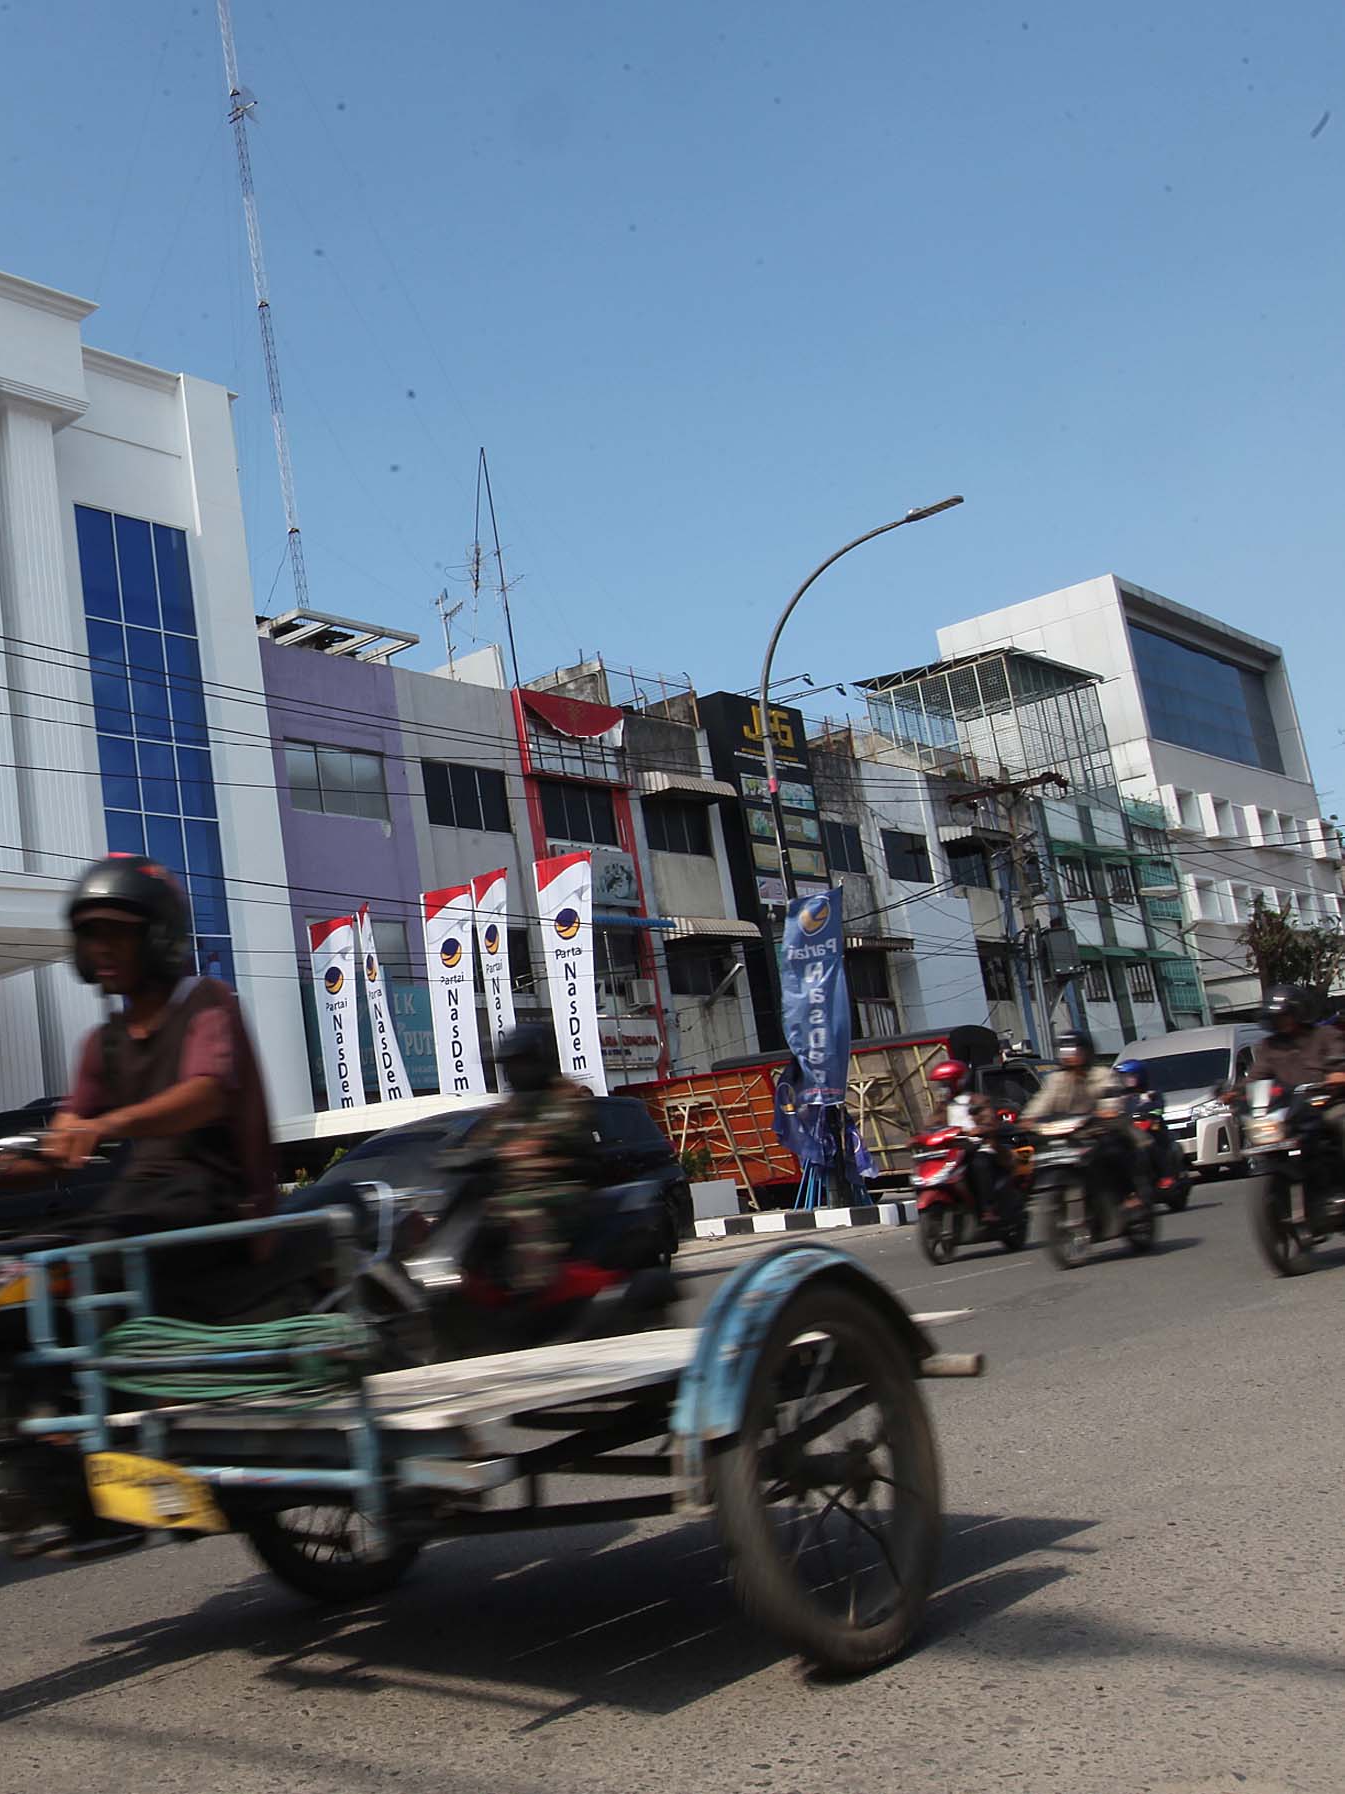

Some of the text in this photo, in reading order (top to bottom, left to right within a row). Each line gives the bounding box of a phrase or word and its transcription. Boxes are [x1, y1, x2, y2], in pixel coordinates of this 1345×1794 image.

[325, 998, 348, 1012] Partai
[440, 971, 465, 985] Partai
[563, 961, 587, 1071] NasDem
[332, 1013, 354, 1109] NasDem
[373, 1001, 403, 1100] NasDem
[447, 988, 469, 1091] NasDem
